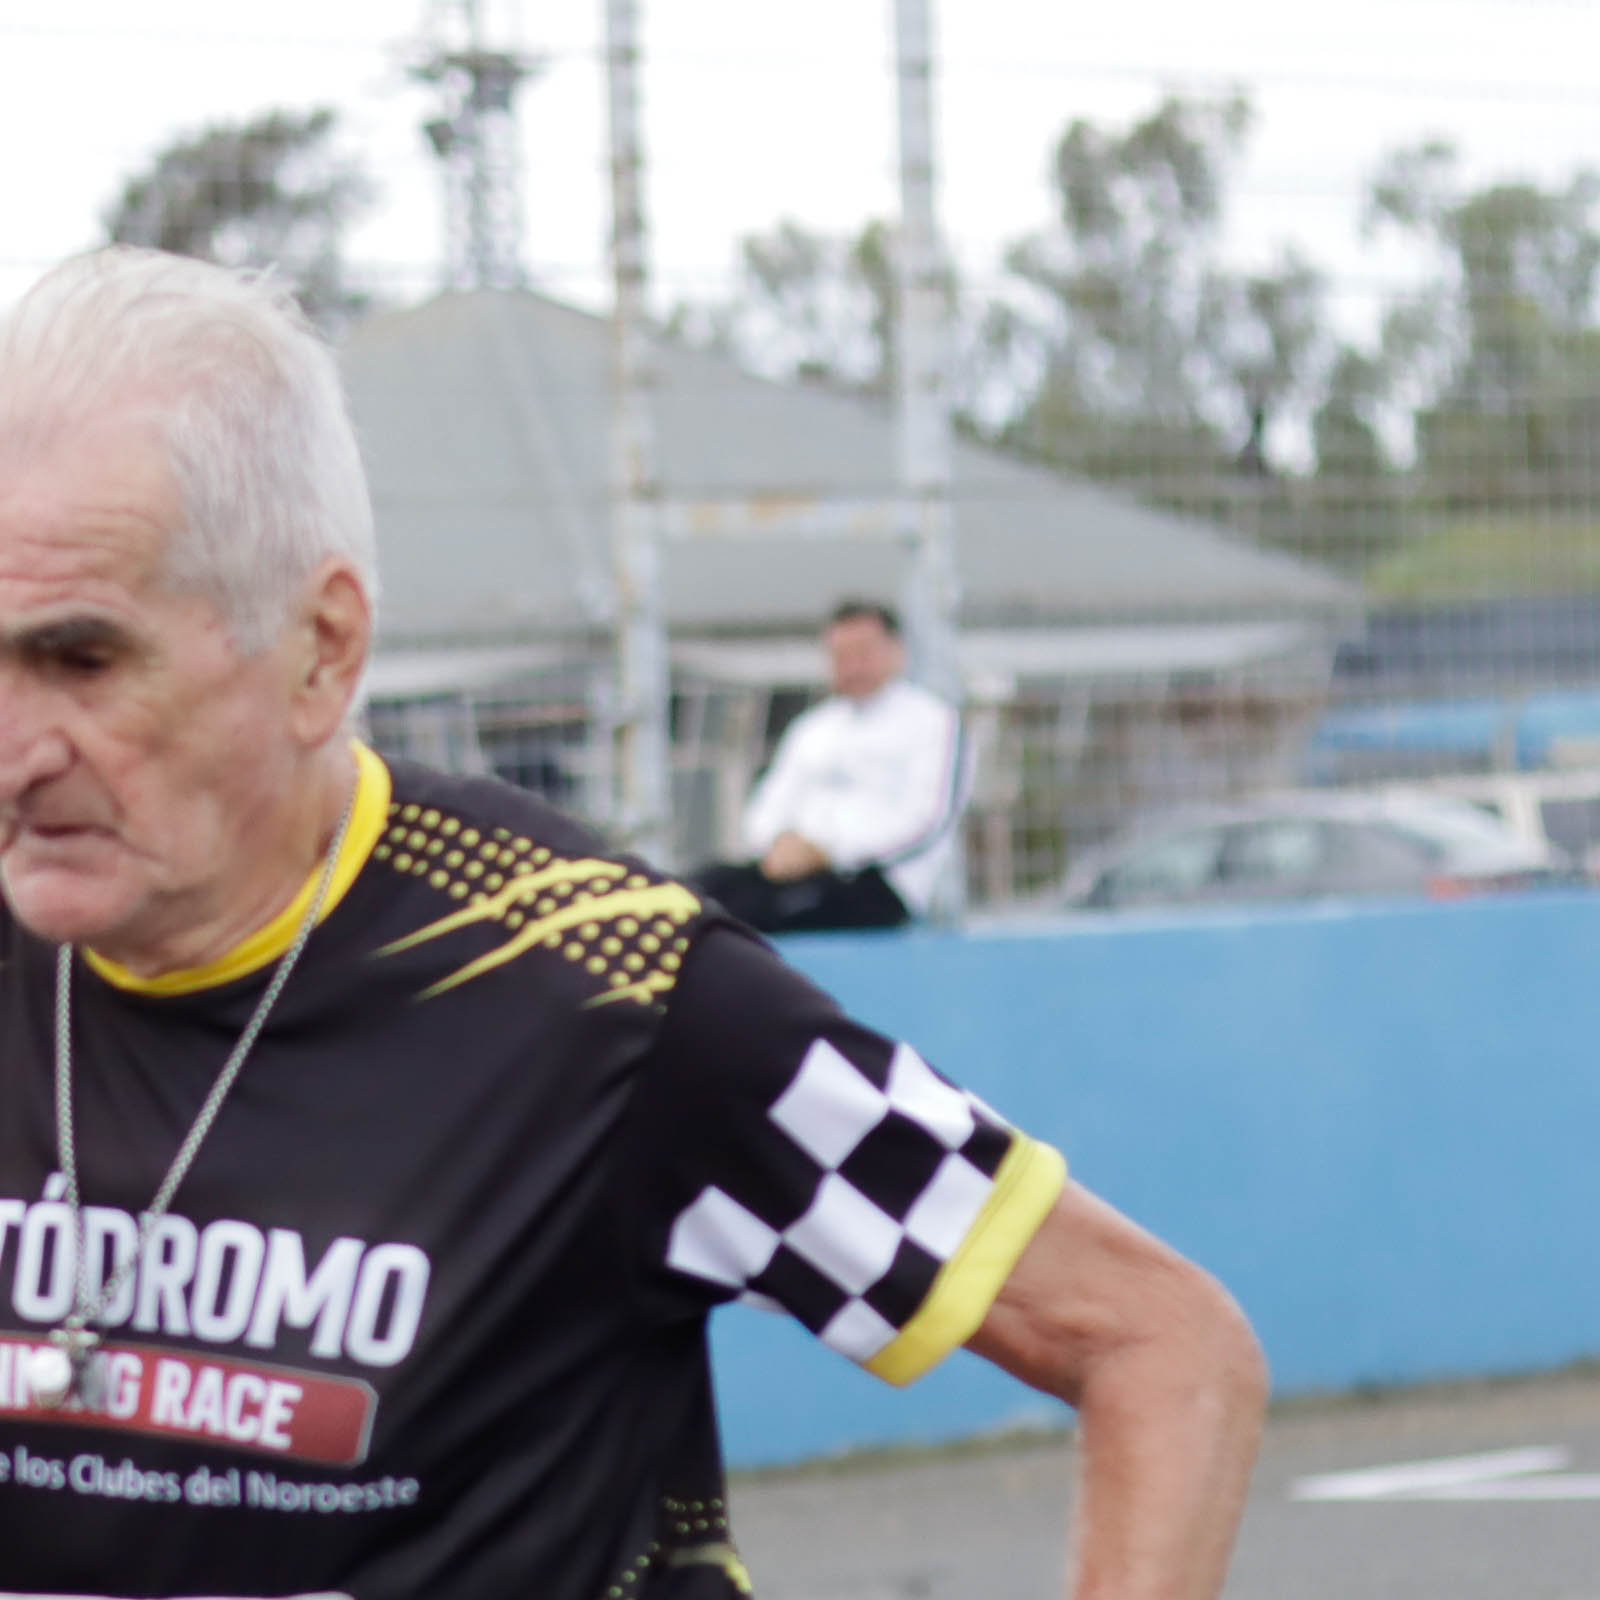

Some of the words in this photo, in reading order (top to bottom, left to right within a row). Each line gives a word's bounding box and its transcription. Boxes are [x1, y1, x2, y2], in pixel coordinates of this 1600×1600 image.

[150, 1358, 305, 1450] RACE
[13, 1444, 66, 1490] los
[68, 1453, 183, 1503] Clubes
[183, 1464, 241, 1508] del
[245, 1469, 421, 1513] Noroeste
